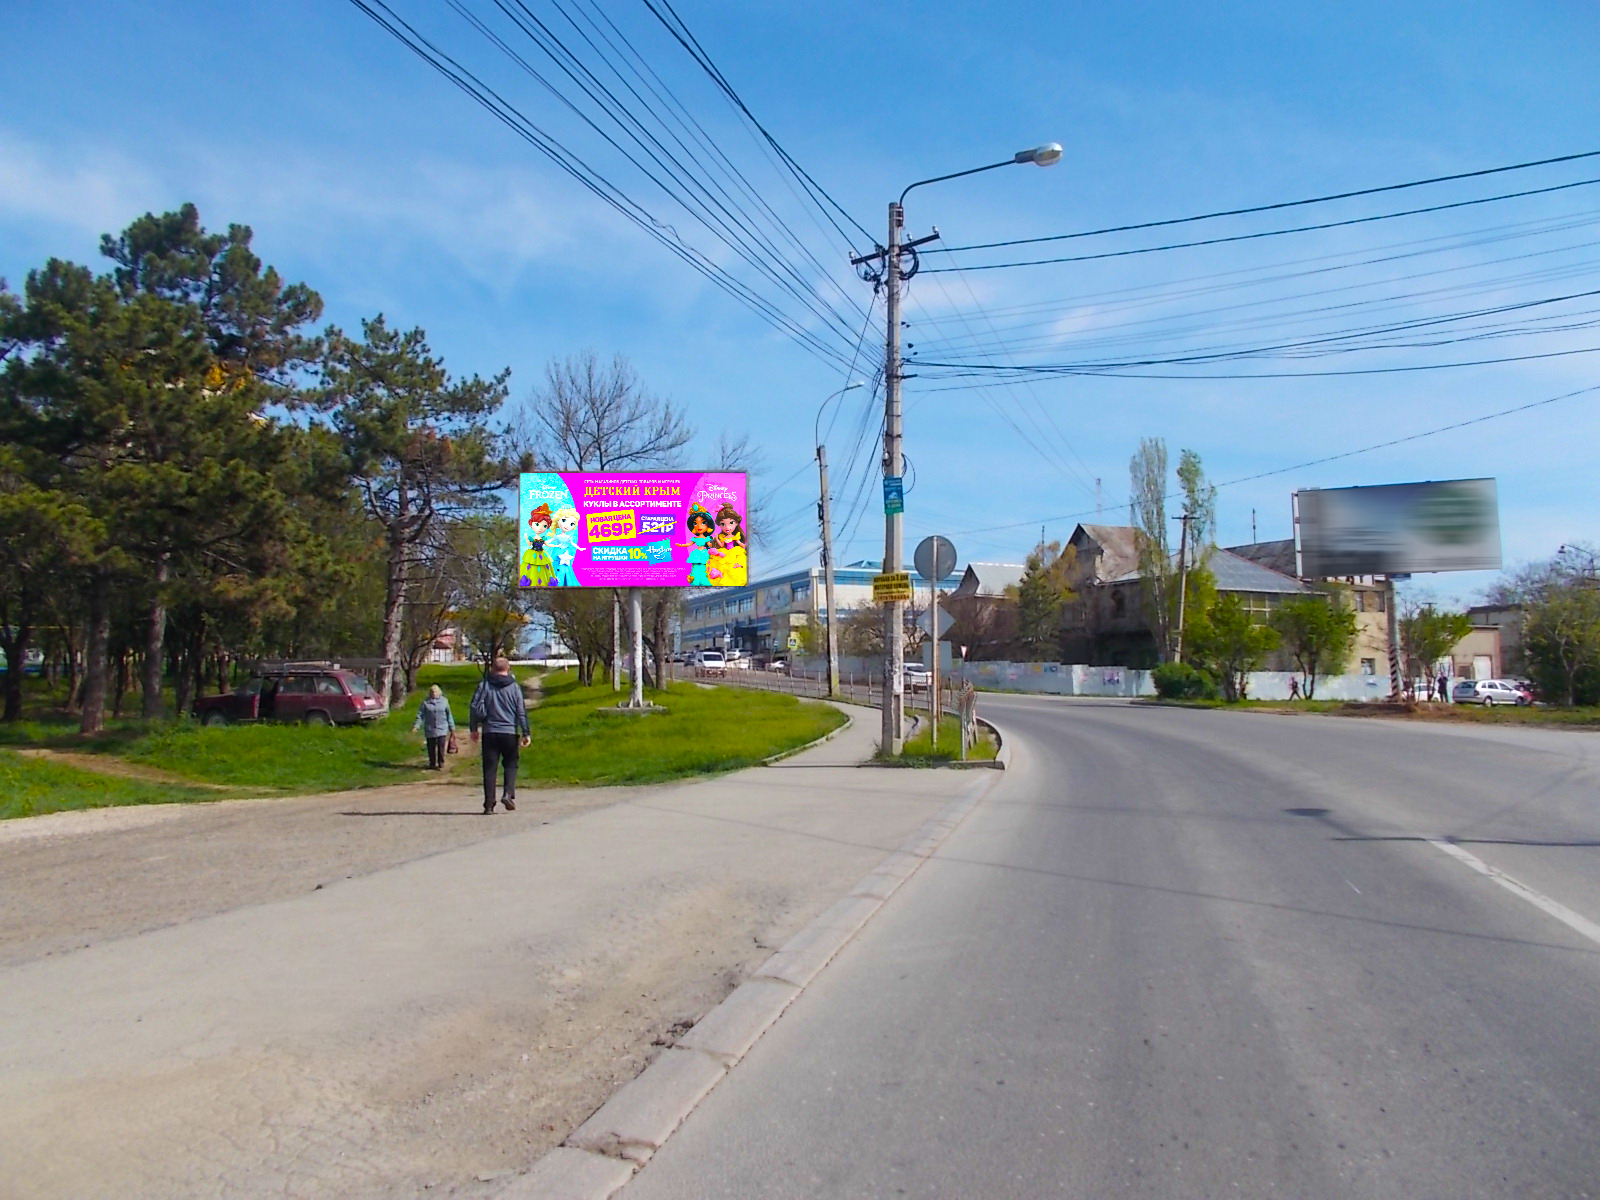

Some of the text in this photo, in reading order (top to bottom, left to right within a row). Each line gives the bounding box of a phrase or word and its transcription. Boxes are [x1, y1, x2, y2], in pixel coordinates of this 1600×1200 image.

[528, 489, 569, 499] FROZEN
[584, 485, 681, 497] ДЕТСКИЙ КРЫМ
[583, 500, 682, 508] КУКЛЫ В АССОРТИМЕНТЕ
[590, 513, 632, 523] НОВАЯ ЦЕНА
[592, 547, 628, 555] СКИДКА
